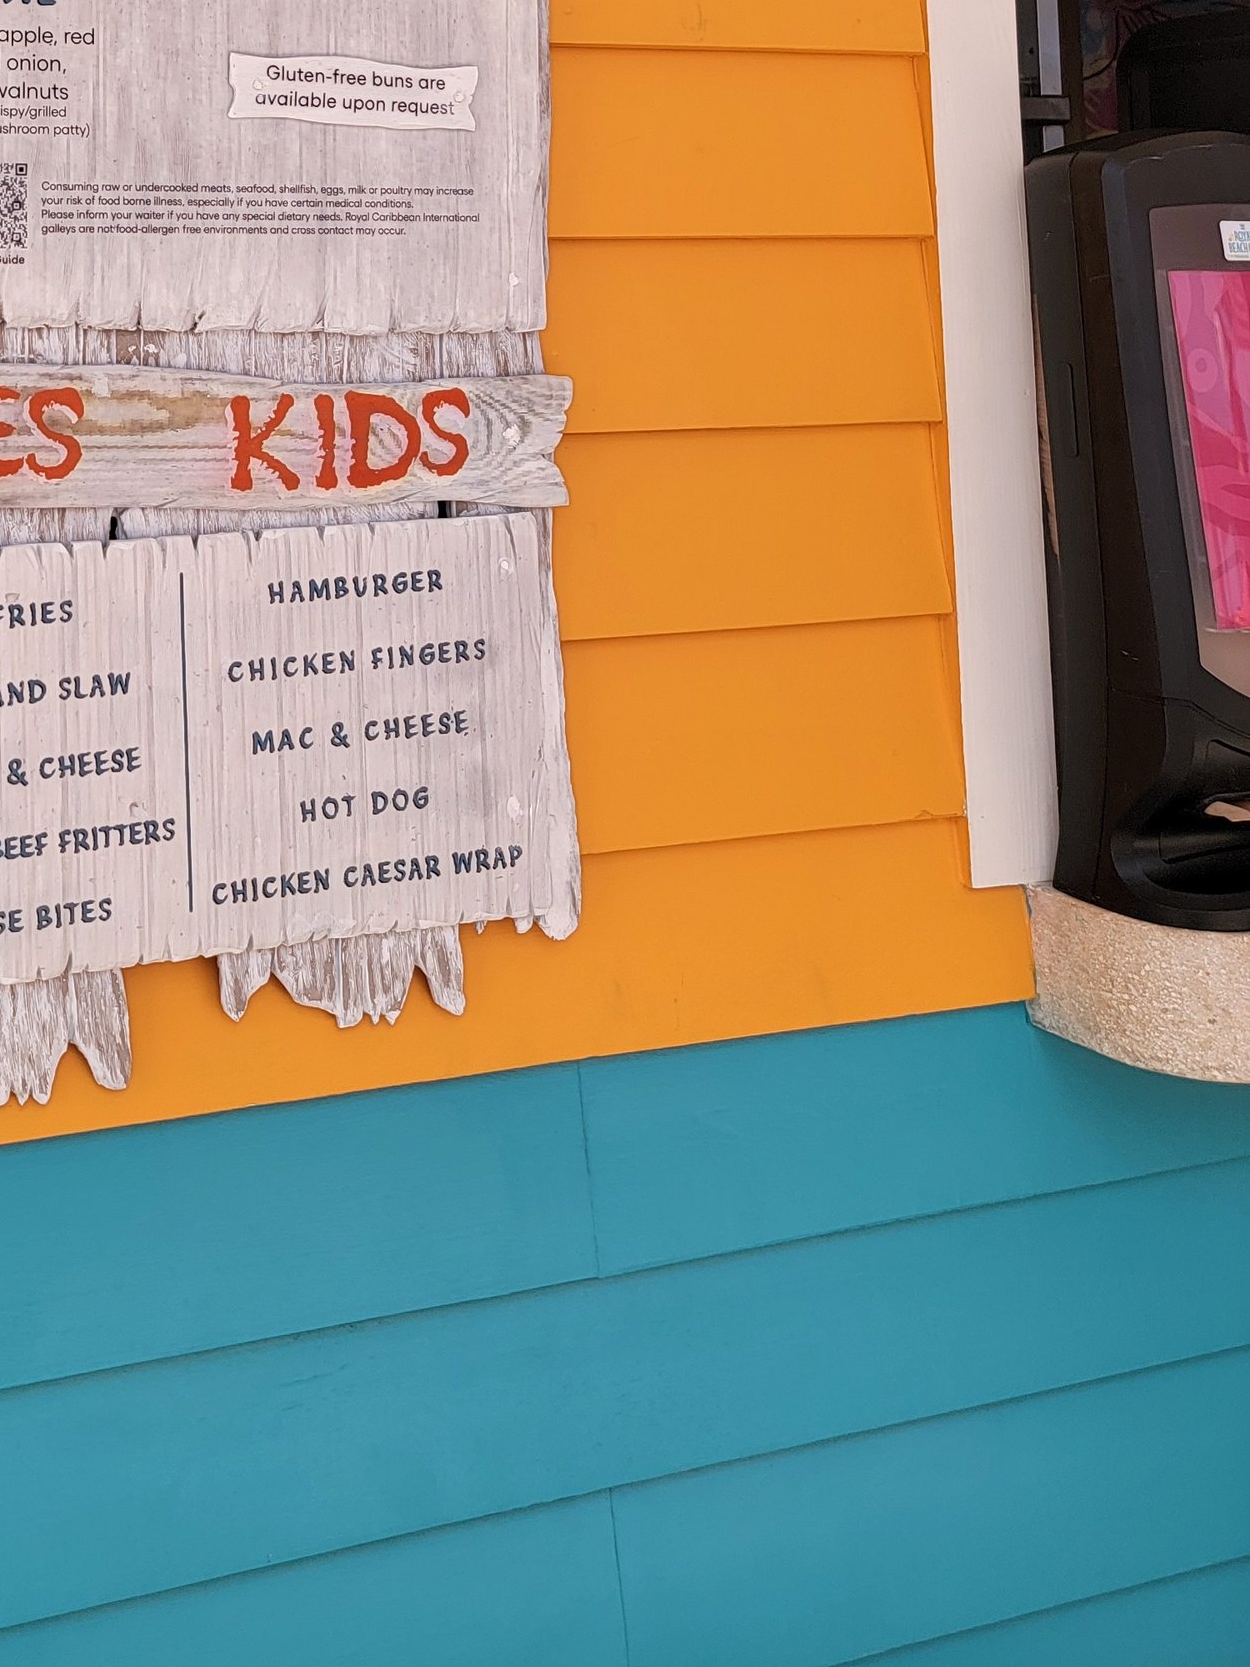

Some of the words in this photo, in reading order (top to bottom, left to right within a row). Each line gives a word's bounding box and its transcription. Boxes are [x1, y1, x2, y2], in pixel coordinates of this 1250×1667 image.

[266, 64, 367, 86] Gluten-free
[372, 71, 413, 88] buns
[418, 78, 446, 90] are
[255, 90, 337, 109] available
[342, 98, 386, 113] upon
[391, 101, 454, 117] request
[53, 123, 90, 138] patty)
[41, 181, 99, 193] Consuming
[122, 184, 133, 192] or
[134, 182, 199, 193] undercooked
[200, 184, 234, 193] meats,
[235, 183, 277, 194] seafood,
[278, 184, 319, 195] shellfish,
[320, 186, 346, 196] eggs,
[348, 185, 367, 194] milk
[380, 186, 413, 197] poultry
[414, 187, 435, 197] may
[436, 186, 474, 196] increase
[229, 388, 470, 492] KIDS
[267, 569, 443, 604] HAMBURGER
[227, 649, 355, 682] CHICKEN
[371, 638, 485, 670] FINGERS
[58, 671, 131, 700] SLAW
[252, 726, 314, 755] MAC
[330, 721, 351, 749] &
[364, 709, 469, 741] CHEESE
[6, 758, 29, 787] &
[39, 746, 142, 779] CHEESE
[299, 795, 356, 823] HOT
[370, 786, 429, 815] DOG
[58, 818, 176, 854] FRITTERS
[212, 868, 330, 905] CHICKEN
[343, 855, 441, 888] CAESAR
[451, 845, 523, 875] WRAP
[36, 897, 112, 931] BITES
